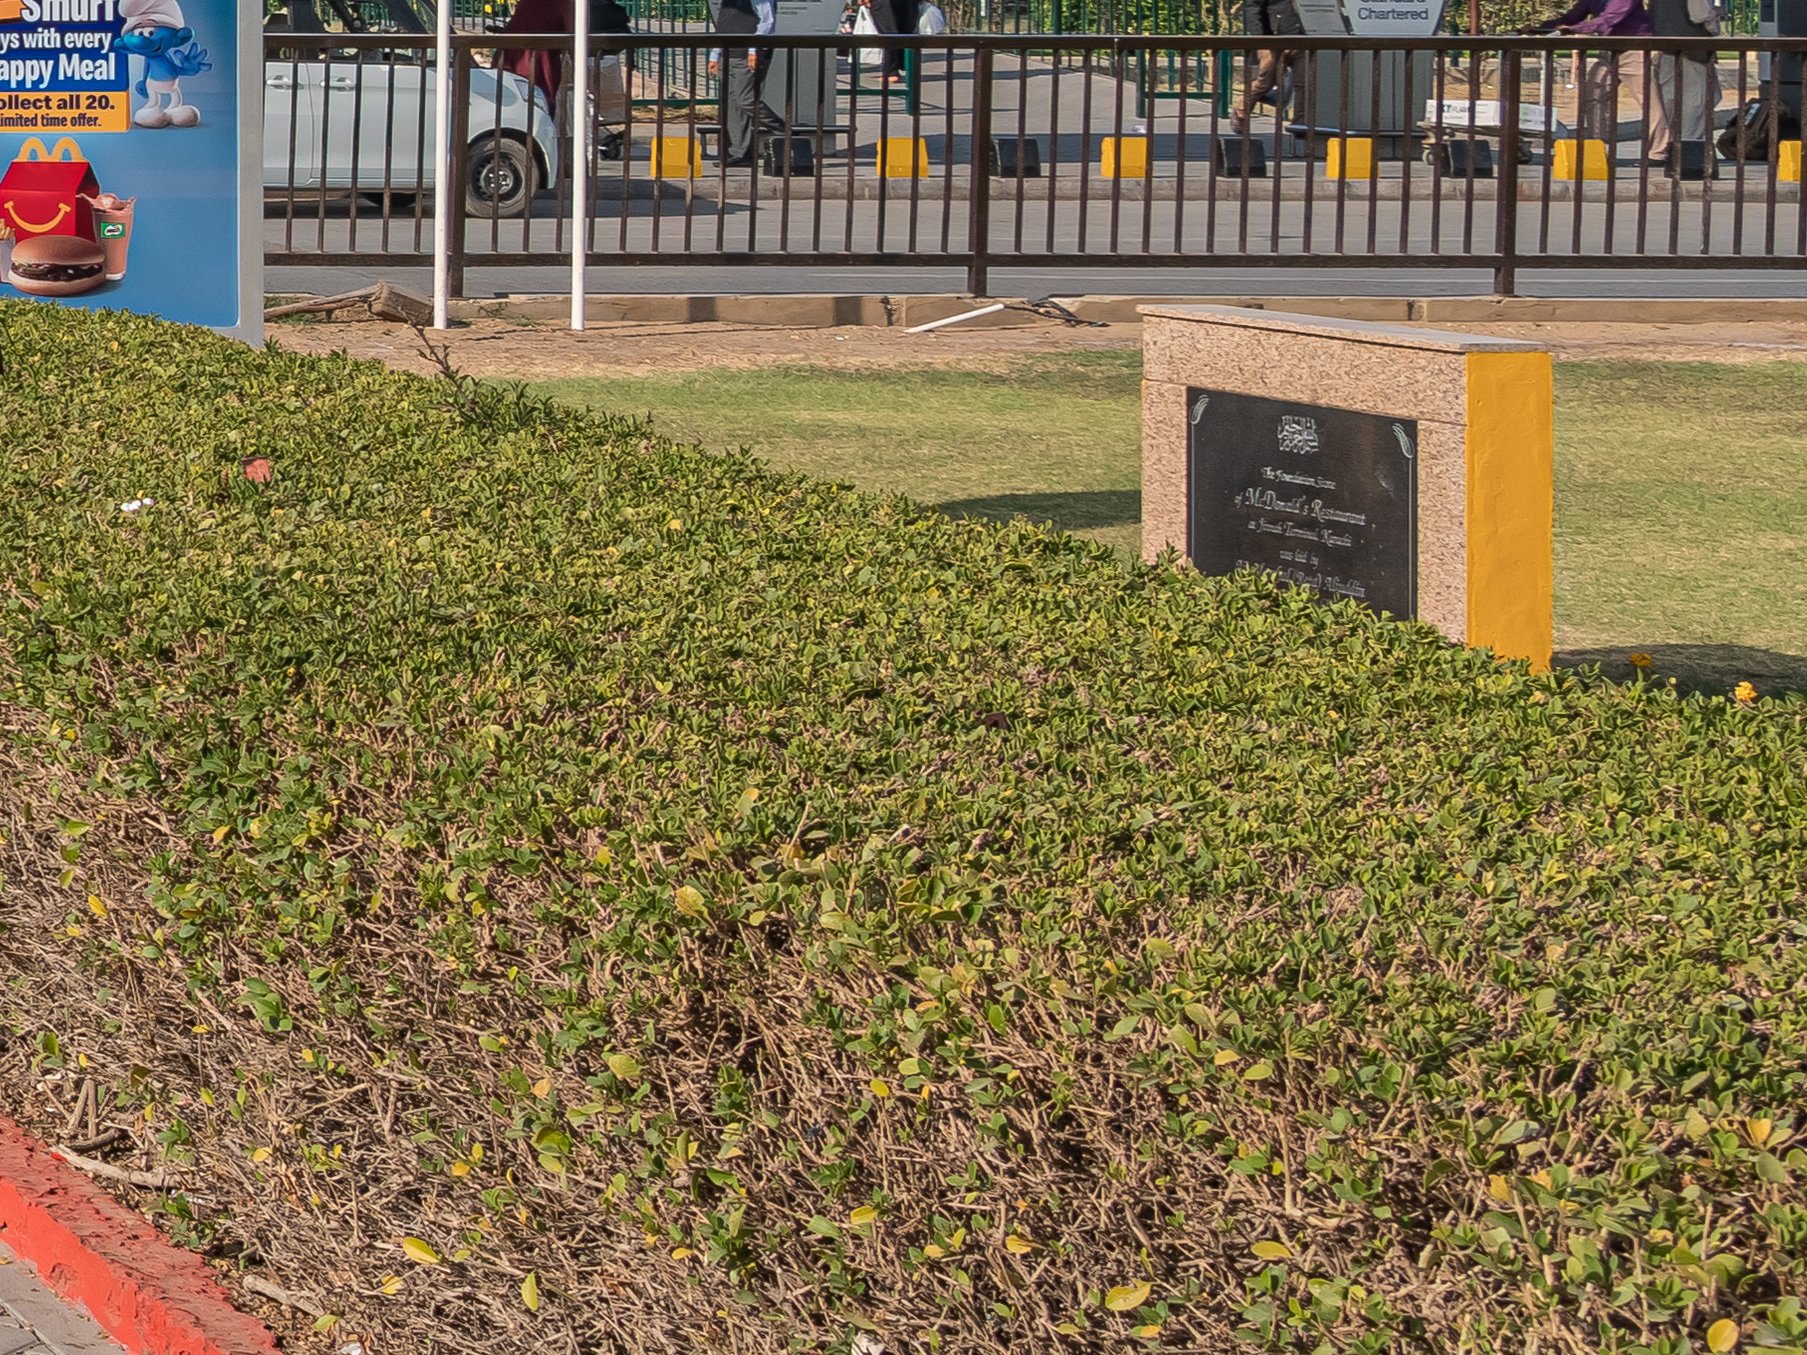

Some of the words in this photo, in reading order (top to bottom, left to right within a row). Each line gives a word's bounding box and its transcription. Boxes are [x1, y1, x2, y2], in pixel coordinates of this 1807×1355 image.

[1357, 7, 1429, 20] Chartered
[23, 27, 61, 49] with
[64, 32, 113, 54] every
[58, 52, 116, 81] Meal
[56, 94, 81, 111] all
[85, 94, 116, 111] 20.
[40, 114, 68, 128] time
[70, 113, 103, 128] offer.
[1245, 487, 1309, 515] McDonald's
[1310, 499, 1366, 525] Restaurant
